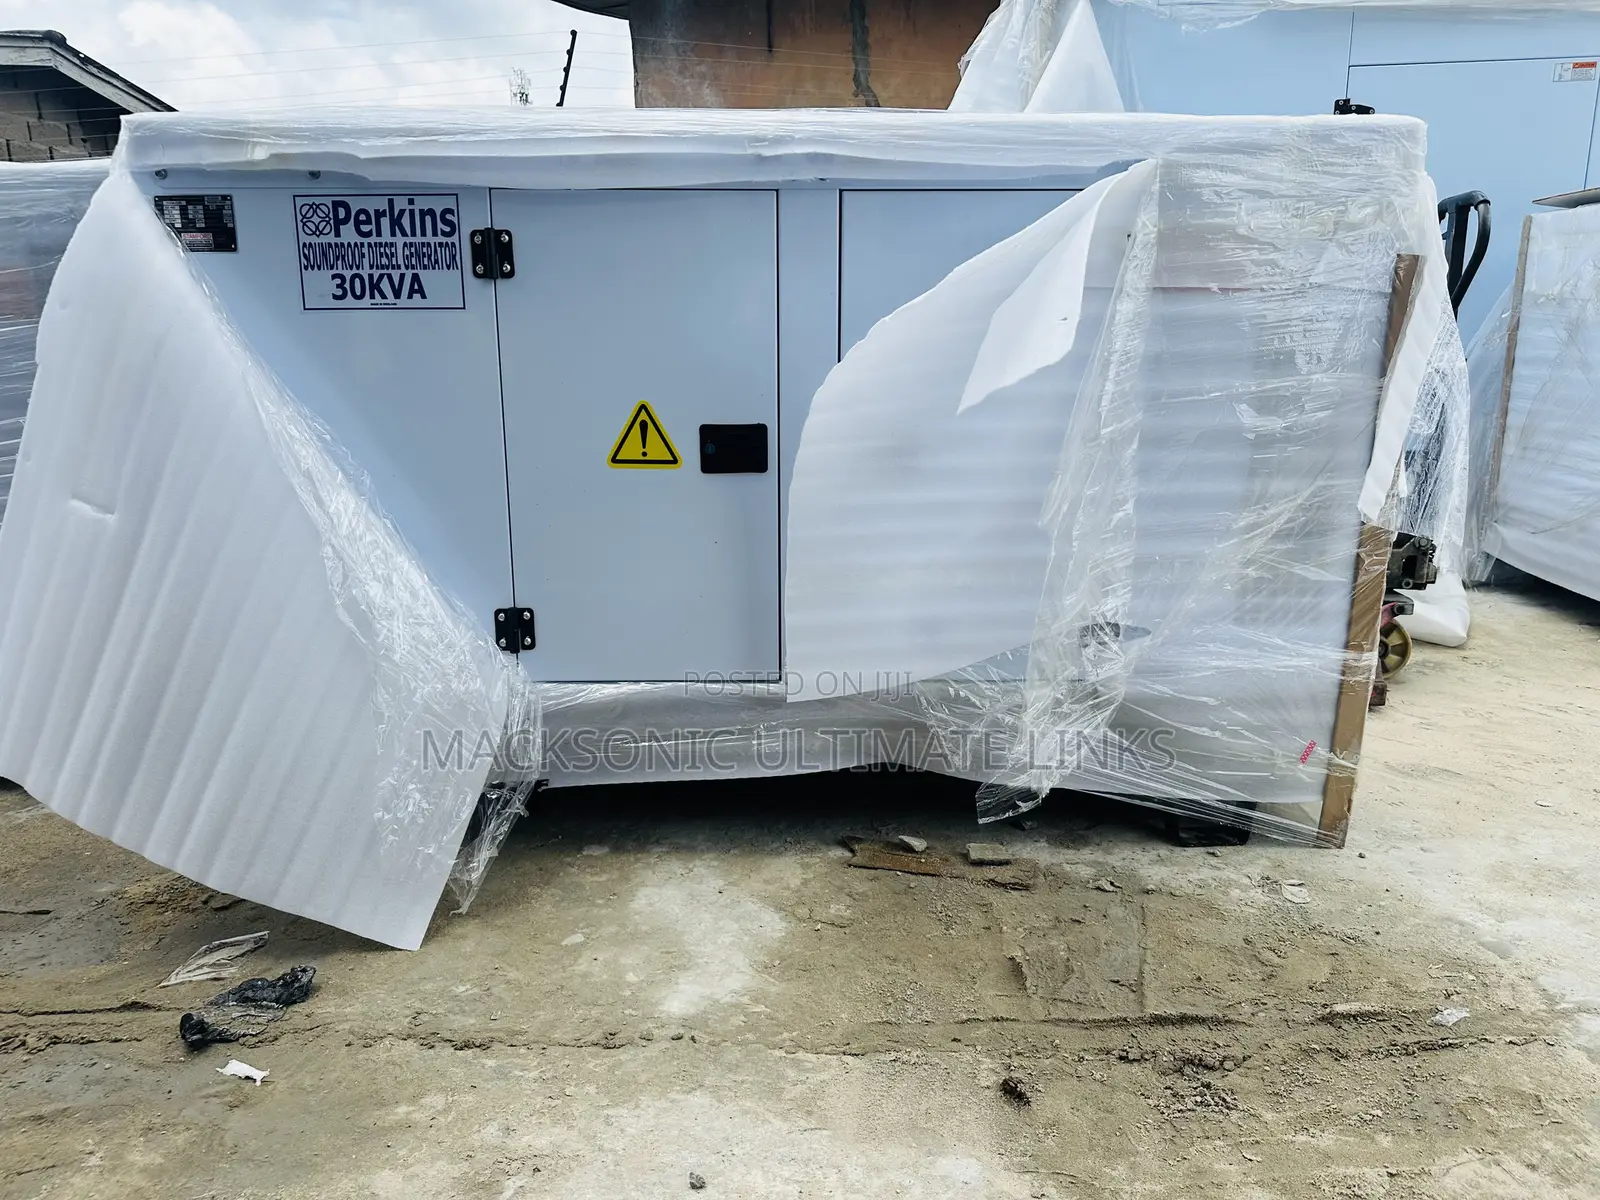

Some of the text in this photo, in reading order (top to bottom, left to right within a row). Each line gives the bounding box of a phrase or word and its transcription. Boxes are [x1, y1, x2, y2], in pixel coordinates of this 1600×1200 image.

[332, 198, 457, 239] Perkins
[302, 241, 459, 271] SOUNDPROOF DIESEL GENERATOR
[331, 273, 428, 301] 30KVA
